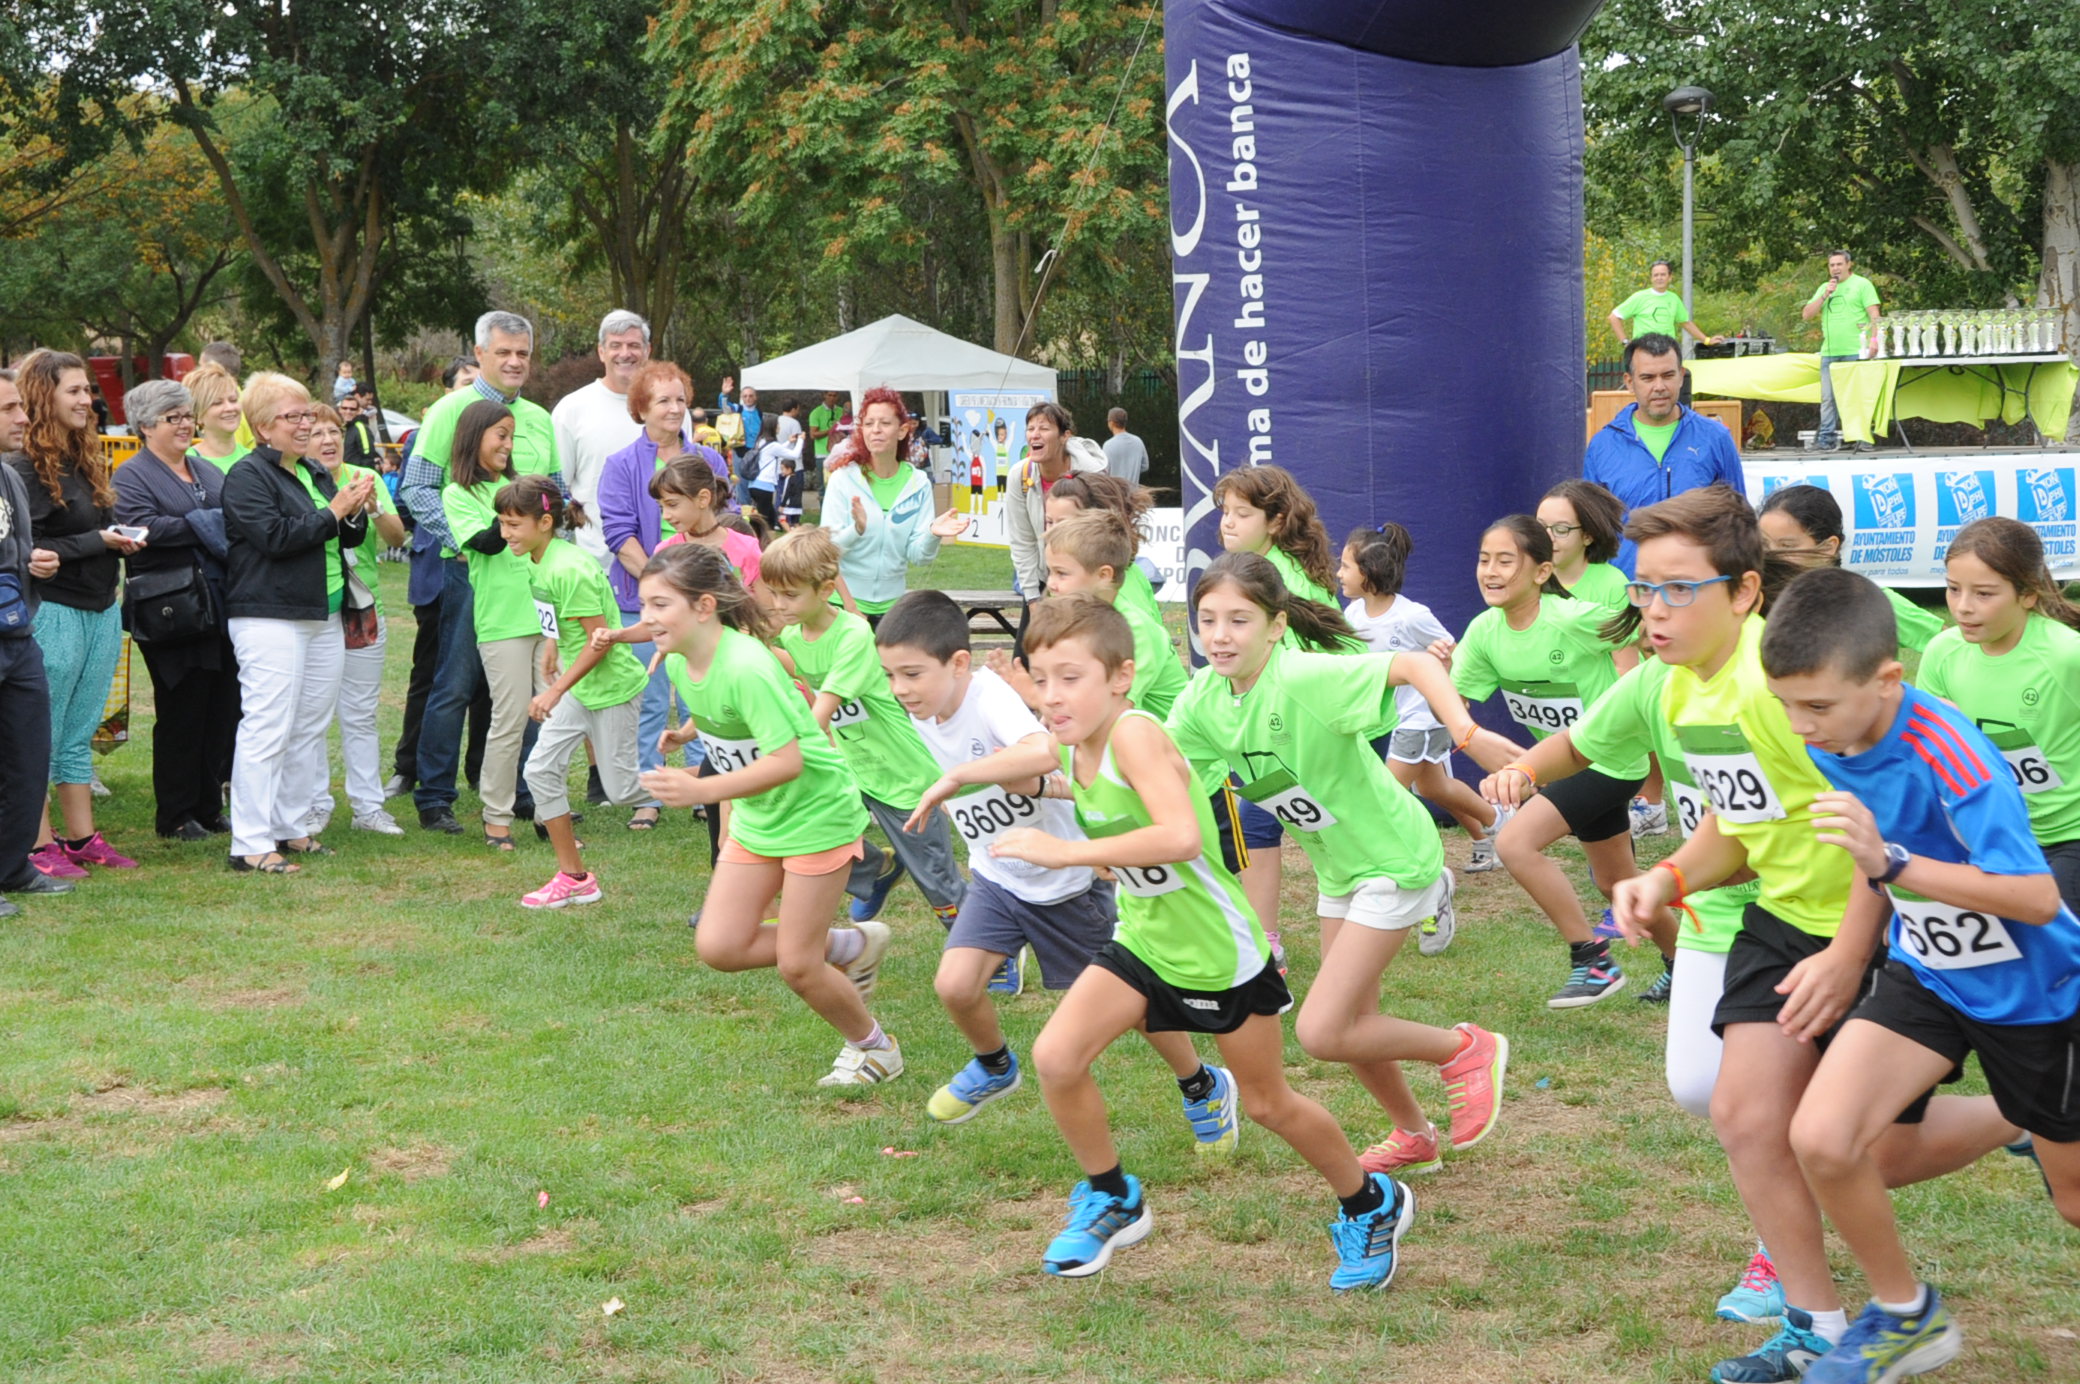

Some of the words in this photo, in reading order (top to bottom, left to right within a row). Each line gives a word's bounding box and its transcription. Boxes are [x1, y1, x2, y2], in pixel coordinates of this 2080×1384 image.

[1226, 52, 1258, 192] banca
[1234, 203, 1266, 328] hacer
[1237, 340, 1270, 397] de
[972, 519, 979, 538] 2
[1853, 531, 1916, 546] AYUNTAMIENTO
[1850, 549, 1862, 563] DE
[1864, 546, 1914, 563] MÓSTOLES
[538, 608, 556, 633] 22
[2024, 692, 2036, 701] 42
[1509, 698, 1579, 728] 3498
[955, 790, 1035, 840] 3609
[1275, 797, 1322, 828] 49
[1678, 795, 1705, 832] 3
[1900, 911, 2004, 957] 662
